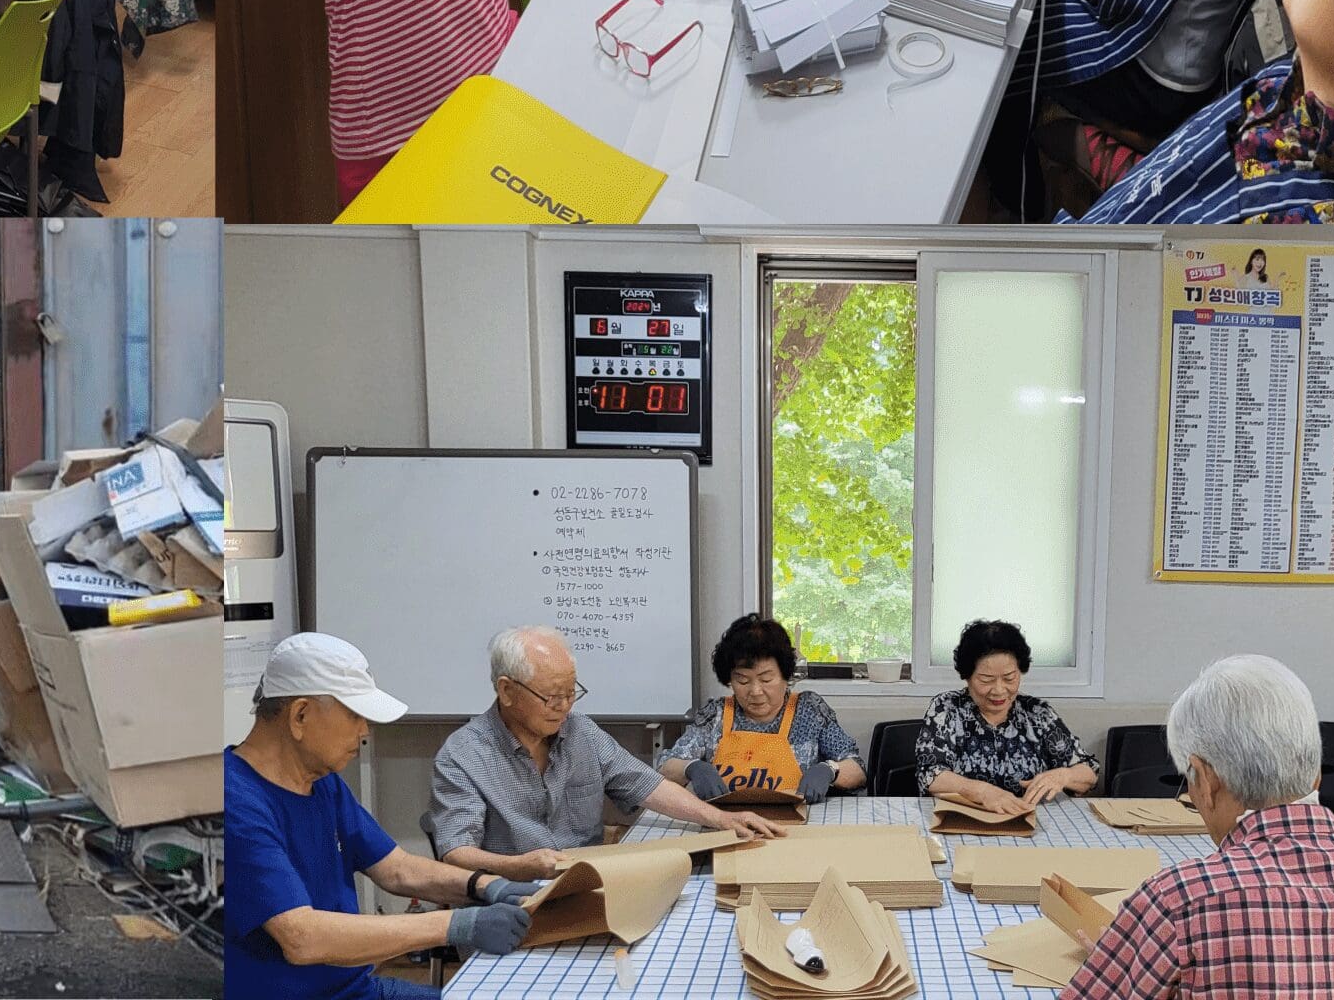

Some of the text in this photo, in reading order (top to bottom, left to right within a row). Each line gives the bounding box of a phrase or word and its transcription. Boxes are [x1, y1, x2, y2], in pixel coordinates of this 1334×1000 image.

[490, 165, 594, 224] COGNEX
[1196, 251, 1205, 260] TJ
[619, 289, 655, 298] KAPPA
[1184, 287, 1281, 307] TJ 성인애창곡
[626, 302, 661, 312] 2024 년
[596, 321, 684, 335] 6 월 27 일
[592, 359, 600, 367] 일
[607, 359, 614, 367] 월
[620, 359, 628, 367] 화
[649, 360, 656, 368] 목
[663, 360, 670, 368] 금
[677, 360, 684, 368] 토
[551, 486, 648, 500] 02-2286-7078
[554, 507, 654, 522] 성동구보건소 골밀도검사
[556, 527, 586, 539] 예약제
[543, 547, 672, 561] 사전연명의료의향서 작성기관
[553, 565, 613, 578] 국민건강보험공단
[618, 566, 650, 578] 성동지사
[556, 582, 604, 591] 1577-1000
[556, 596, 649, 607] 왕십리도선동 노인복지관
[557, 611, 635, 622] 070-4070-4359
